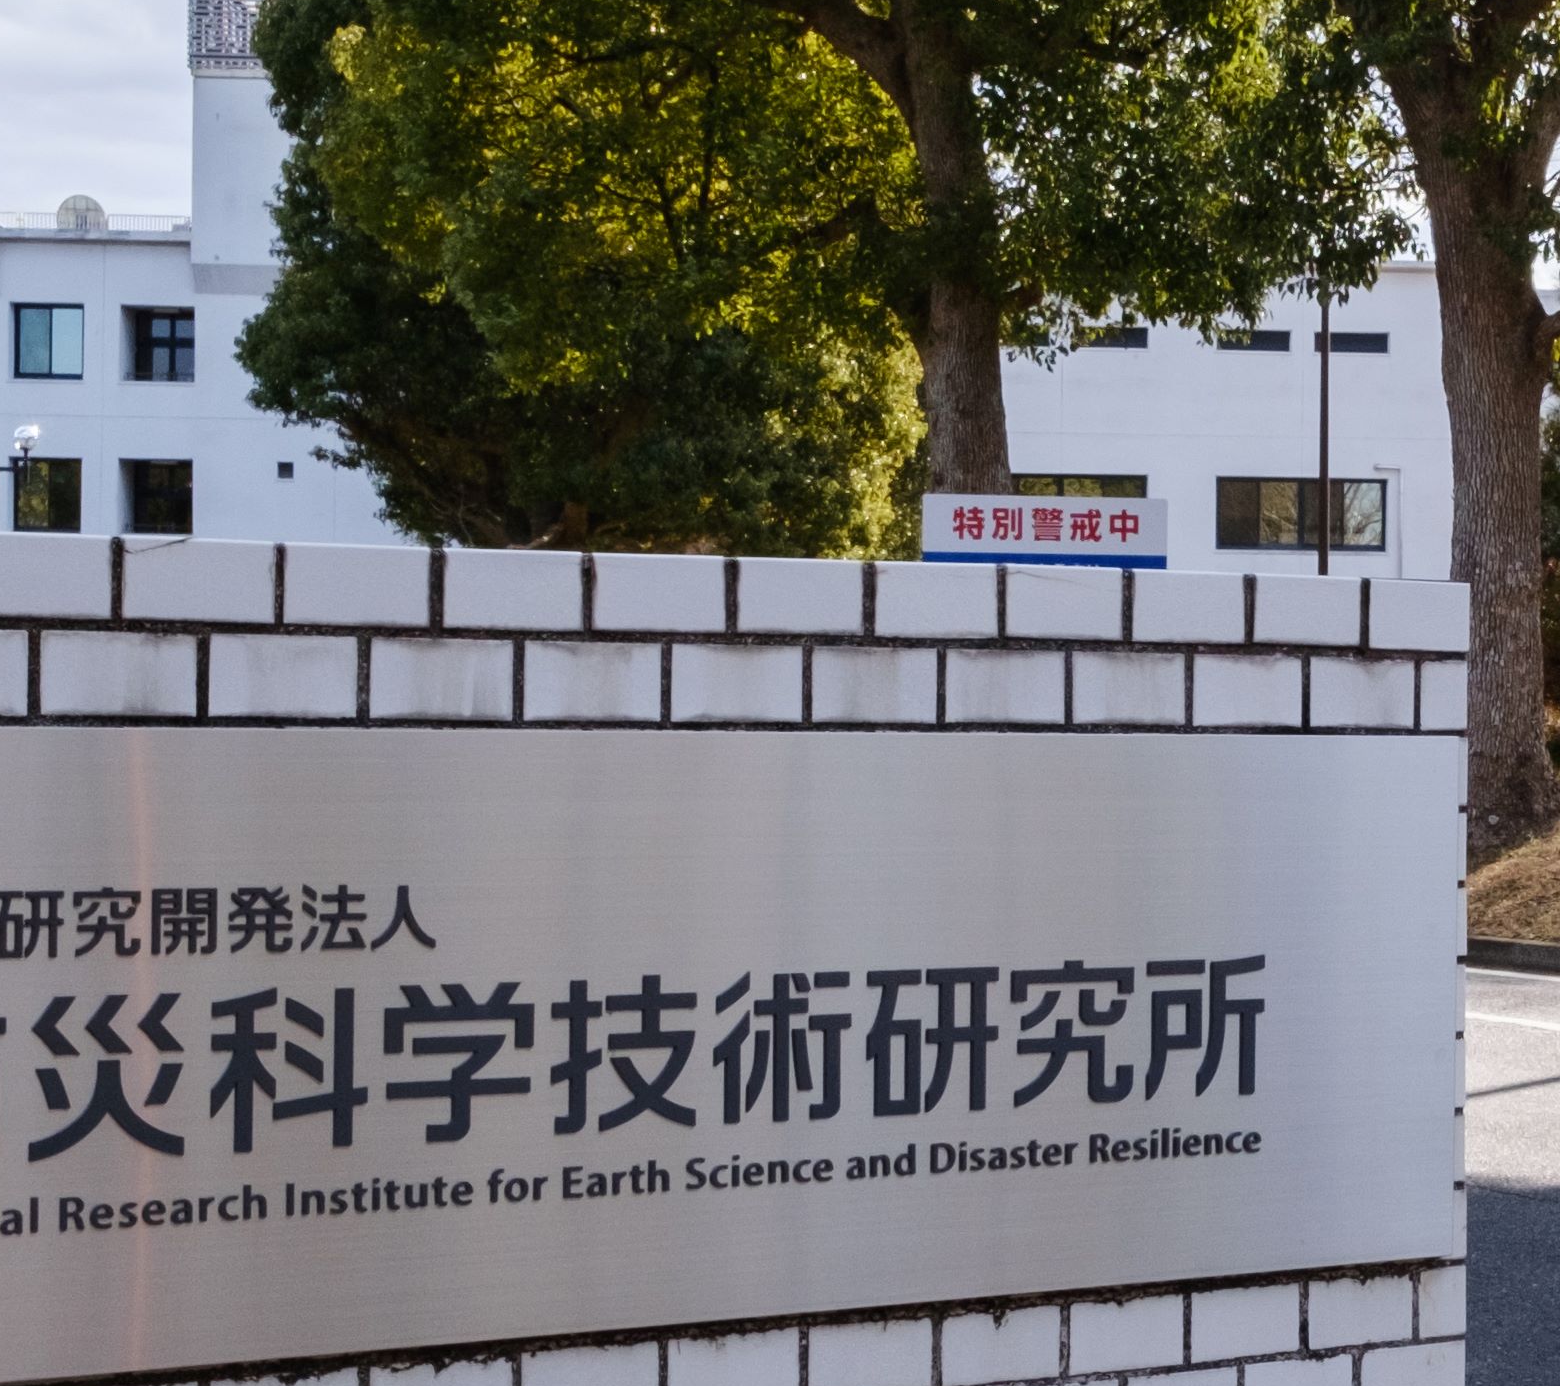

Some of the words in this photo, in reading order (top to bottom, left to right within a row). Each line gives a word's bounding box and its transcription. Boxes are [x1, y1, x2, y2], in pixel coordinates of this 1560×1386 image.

[952, 506, 1140, 543] 特別警戒中
[57, 1183, 269, 1235] Research
[284, 1175, 475, 1221] Institute
[487, 1167, 549, 1206] for
[561, 1159, 671, 1202] Earth
[684, 1156, 835, 1194] Science
[845, 1143, 917, 1182] and
[928, 1139, 1078, 1176] Disaster
[1087, 1126, 1263, 1166] Resilience
